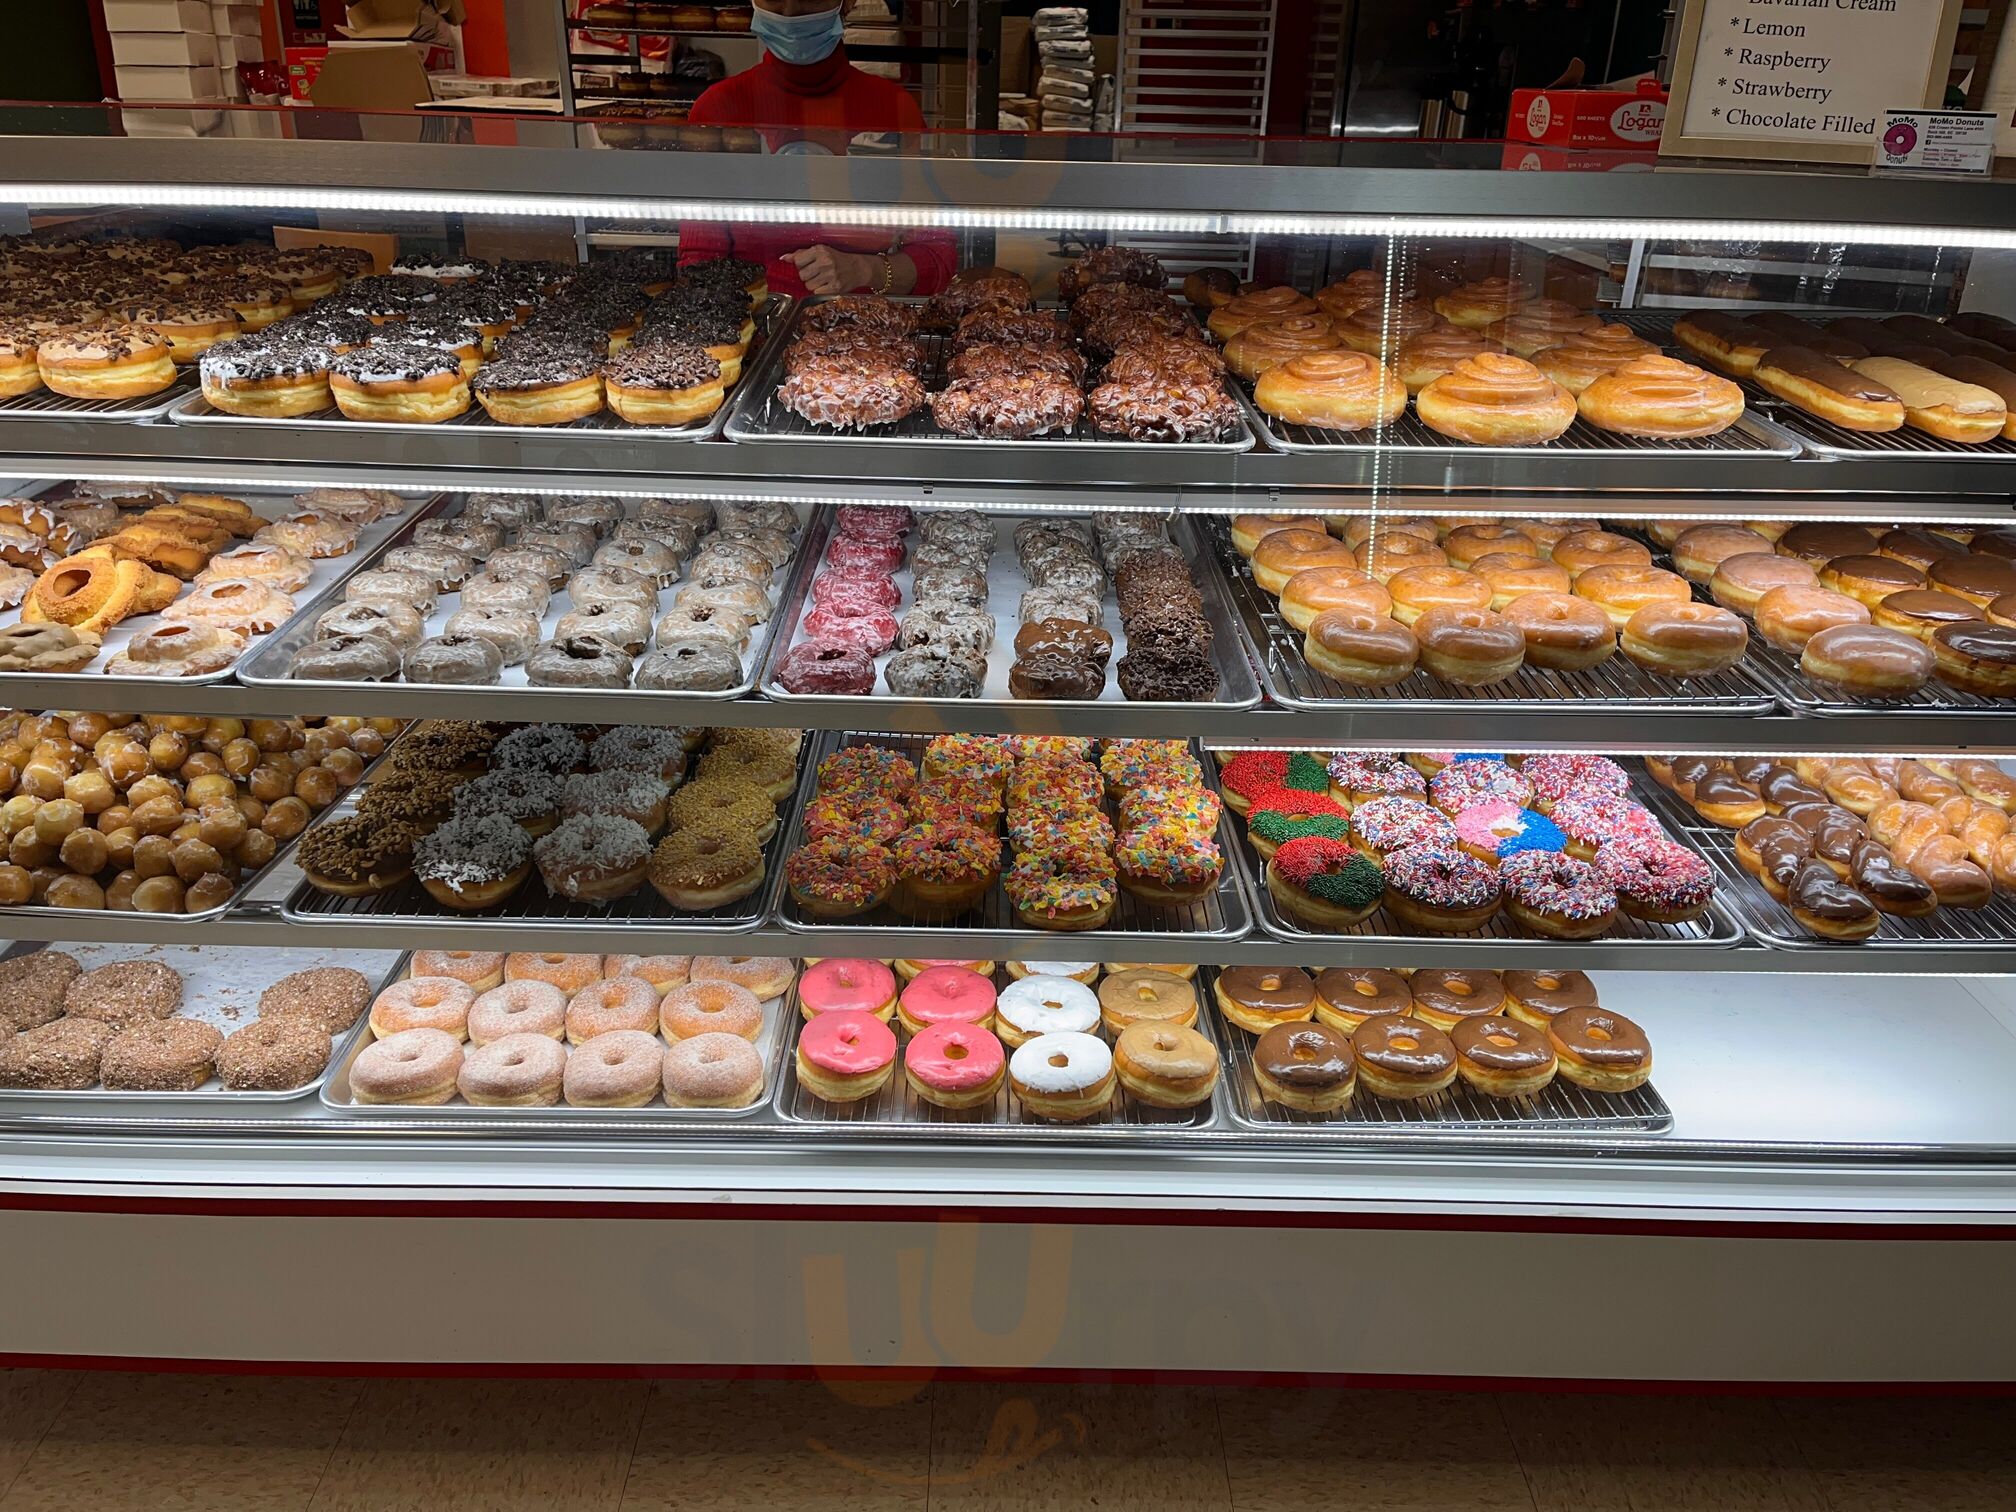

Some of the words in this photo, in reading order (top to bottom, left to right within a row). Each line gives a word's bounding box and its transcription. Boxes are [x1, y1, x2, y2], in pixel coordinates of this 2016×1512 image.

[1749, 0, 1829, 8] arian
[1836, 0, 1896, 11] Cream
[1742, 18, 1805, 37] Lemon
[1738, 48, 1831, 73] Raspberry
[1732, 78, 1832, 104] Strawberry
[1726, 108, 1816, 130] Chocolate
[1822, 115, 1876, 134] Filled
[1886, 116, 1918, 128] MoMo
[1929, 117, 1954, 125] MoMo
[1955, 118, 1985, 126] Donuts
